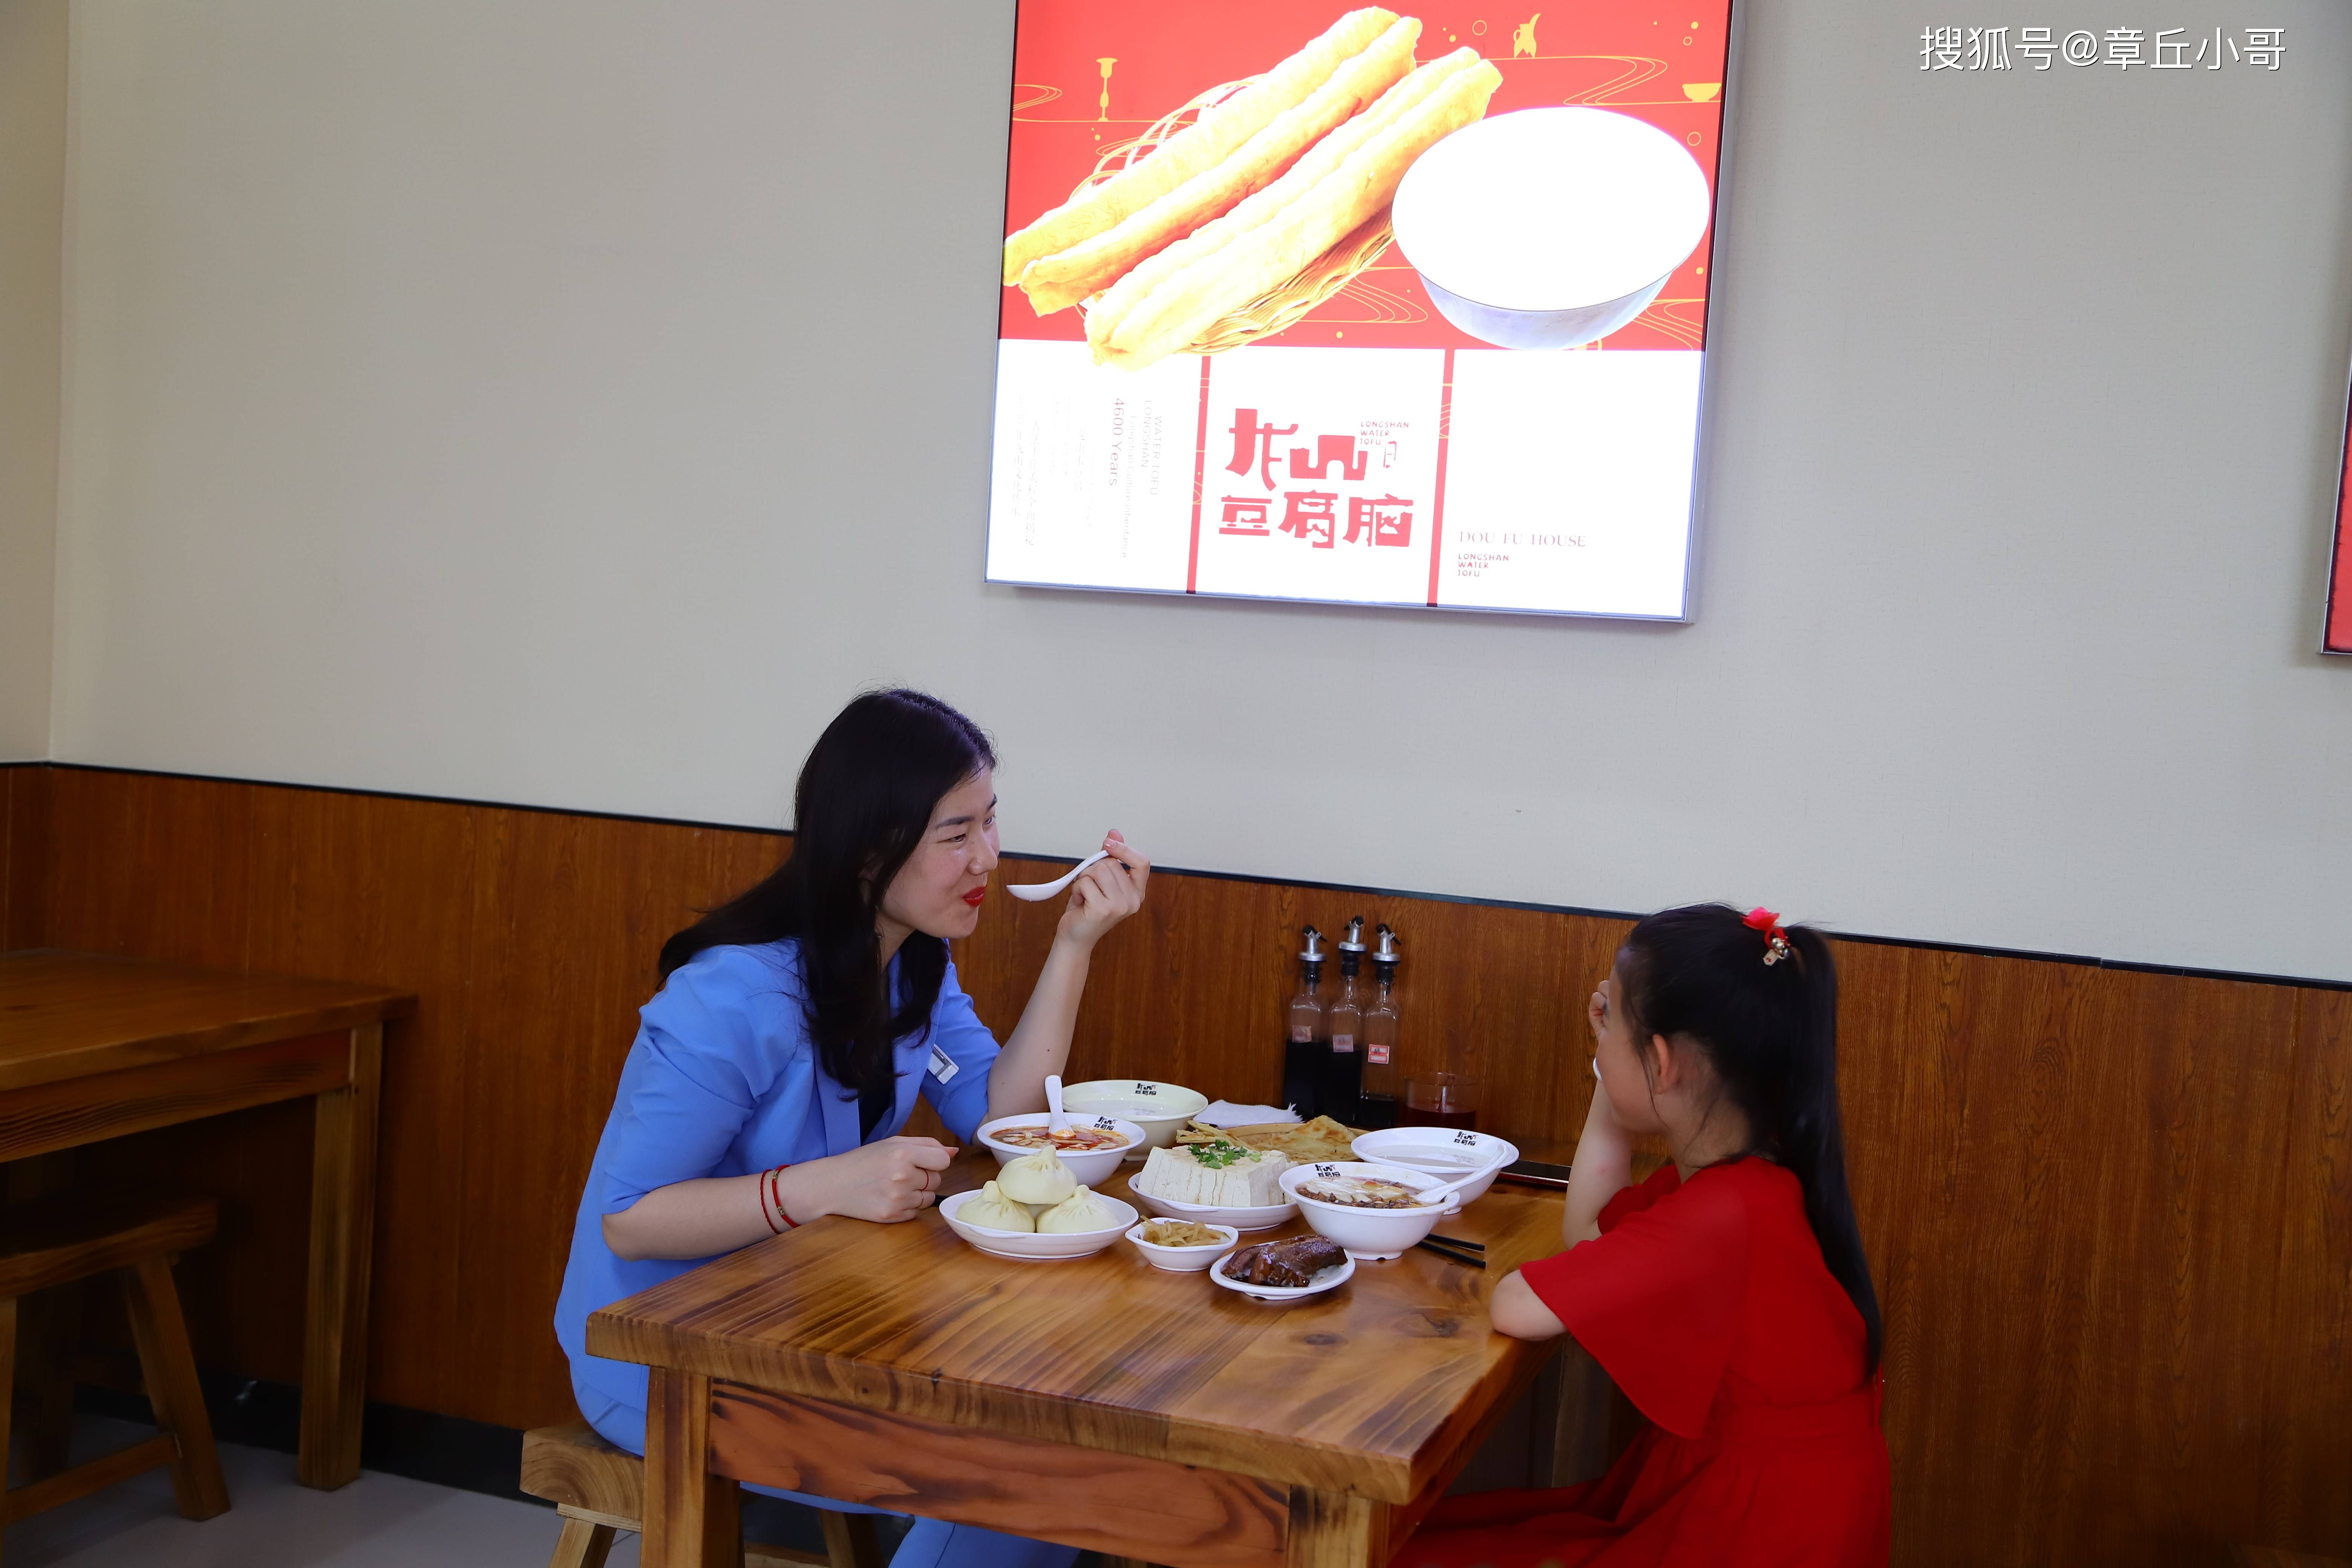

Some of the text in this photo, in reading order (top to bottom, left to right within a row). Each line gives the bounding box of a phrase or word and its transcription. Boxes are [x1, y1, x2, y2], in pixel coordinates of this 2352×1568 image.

[1109, 398, 1124, 485] 4600 Years
[1141, 400, 1152, 467] LONGSHAN
[1150, 415, 1162, 495] WATER TOFU
[1219, 490, 1413, 548] 豆腐脑
[1460, 531, 1585, 547] DOU FU HOUSE
